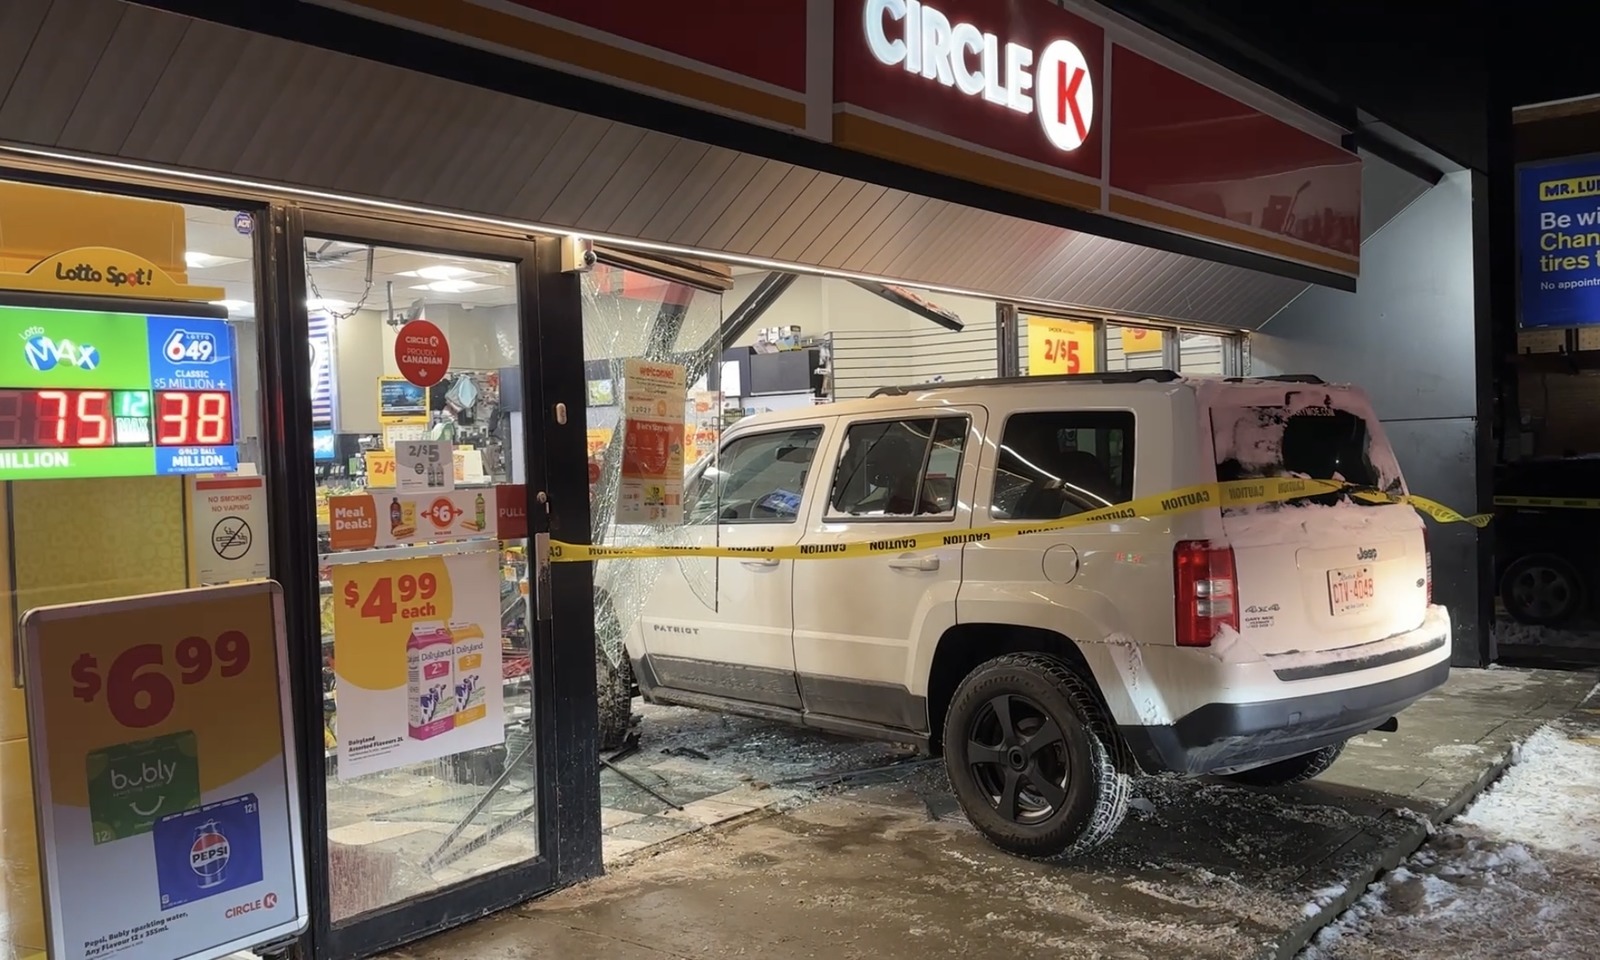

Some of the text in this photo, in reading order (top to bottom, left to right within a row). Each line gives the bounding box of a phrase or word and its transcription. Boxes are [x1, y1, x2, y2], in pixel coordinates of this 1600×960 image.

[864, 0, 1033, 115] CIRCLE
[1544, 183, 1576, 198] MR.
[1541, 212, 1572, 230] Be
[1540, 231, 1600, 251] Chan
[1540, 254, 1590, 272] tires
[56, 262, 153, 287] Lotto Spot!
[1540, 281, 1555, 290] No
[18, 326, 45, 341] Lotto
[405, 336, 439, 347] CIRCLE K
[24, 336, 97, 371] MAX
[407, 348, 438, 356] PROUDLY
[1044, 339, 1080, 374] 2/$5
[402, 356, 442, 364] CANADIAN
[174, 369, 210, 378] CLASSIC
[154, 378, 166, 389] $5
[168, 379, 214, 389] MILLION
[122, 390, 149, 418] 12
[38, 391, 107, 445] 75
[160, 392, 226, 444] 38
[408, 444, 440, 462] 2/$5
[172, 455, 224, 468] MILLION
[335, 506, 364, 518] Meal
[433, 506, 450, 522] $6
[500, 507, 525, 518] PULL
[336, 518, 372, 530] Deals!
[868, 538, 916, 550] CAUTION
[943, 532, 991, 545] CAUTION
[800, 544, 846, 554] CAUTION
[1356, 546, 1377, 560] Jeep
[401, 602, 436, 618] each
[654, 624, 700, 635] PATRIOT
[421, 648, 452, 662] Dairyland
[456, 643, 484, 655] Dairyland
[348, 736, 376, 746] Dairyland
[348, 742, 373, 752] Assorted
[374, 739, 397, 748] Flavours
[110, 759, 176, 790] bubly
[244, 804, 254, 814] 12
[96, 831, 108, 842] 12
[192, 846, 228, 864] PEPSI
[225, 893, 276, 919] CIRCLE K
[84, 912, 188, 948] Pepsi, Bubly sparkling water,
[85, 947, 100, 956] Any
[102, 938, 130, 951] Flavour
[130, 934, 138, 942] 12
[145, 925, 169, 937] 355mL
